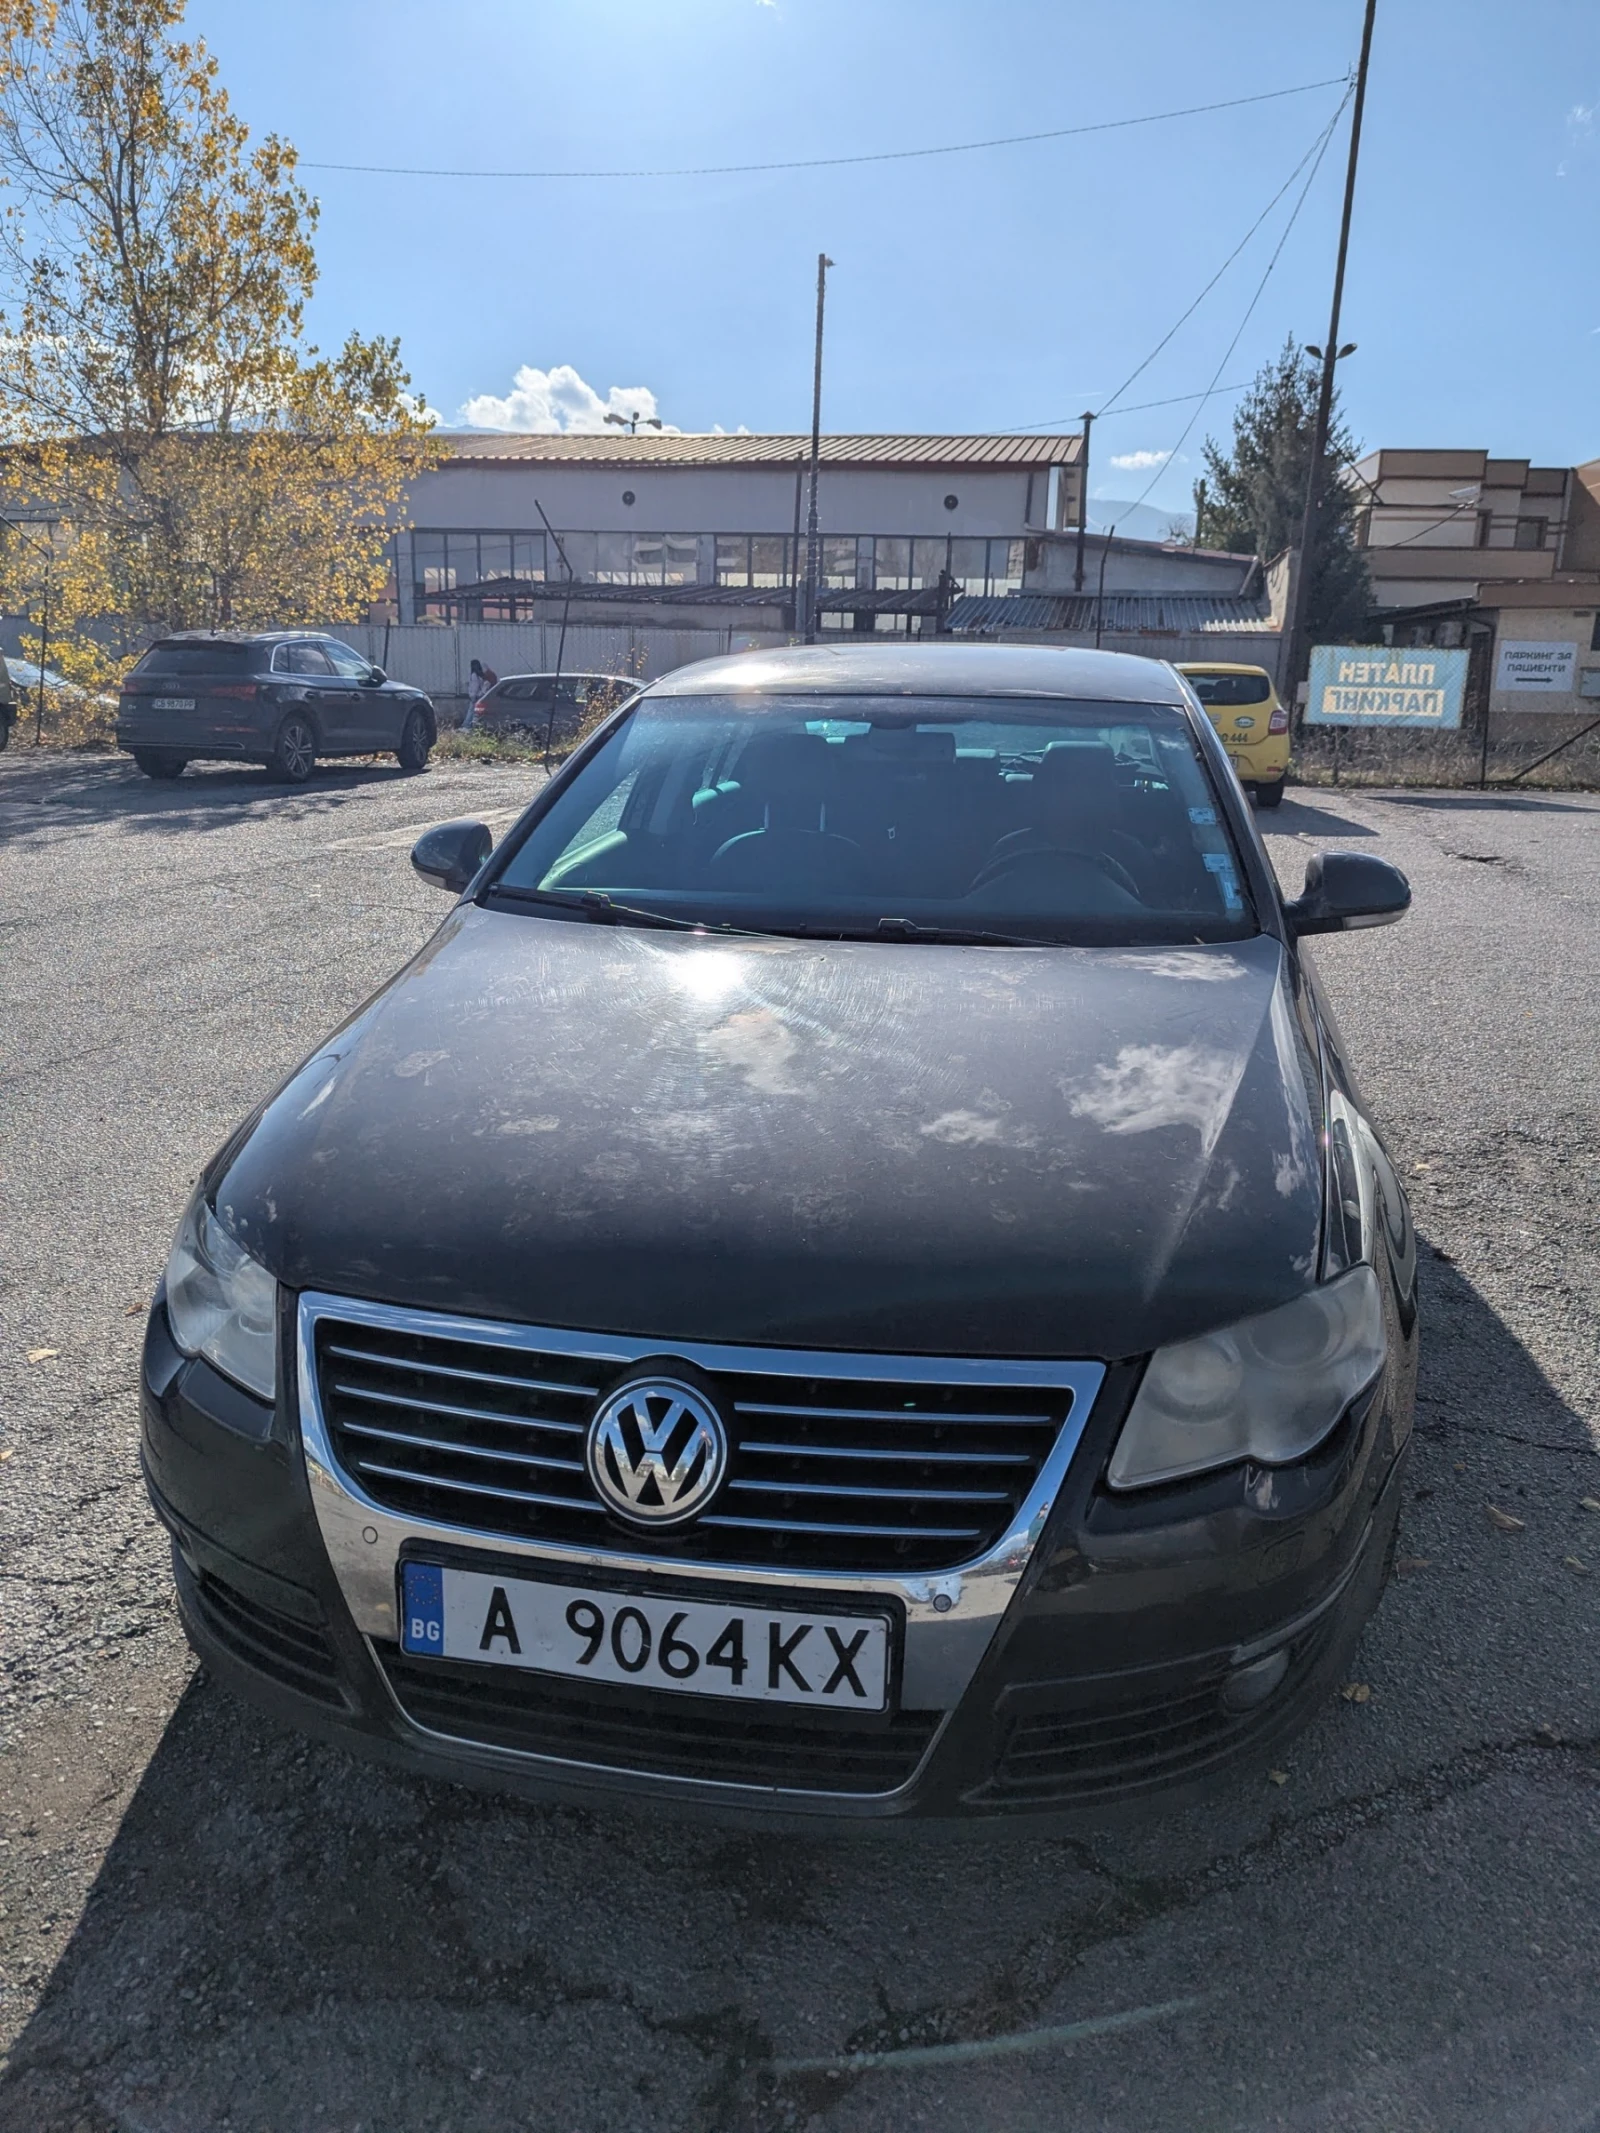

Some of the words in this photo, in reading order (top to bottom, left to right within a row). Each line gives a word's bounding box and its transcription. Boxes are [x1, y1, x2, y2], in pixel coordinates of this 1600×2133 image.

[1504, 651, 1555, 660] ПАРКИНГ
[1557, 652, 1573, 661] ЗА
[1507, 664, 1566, 673] ПАЦИЕНТИ
[479, 1586, 522, 1655] A
[411, 1617, 441, 1643] BG
